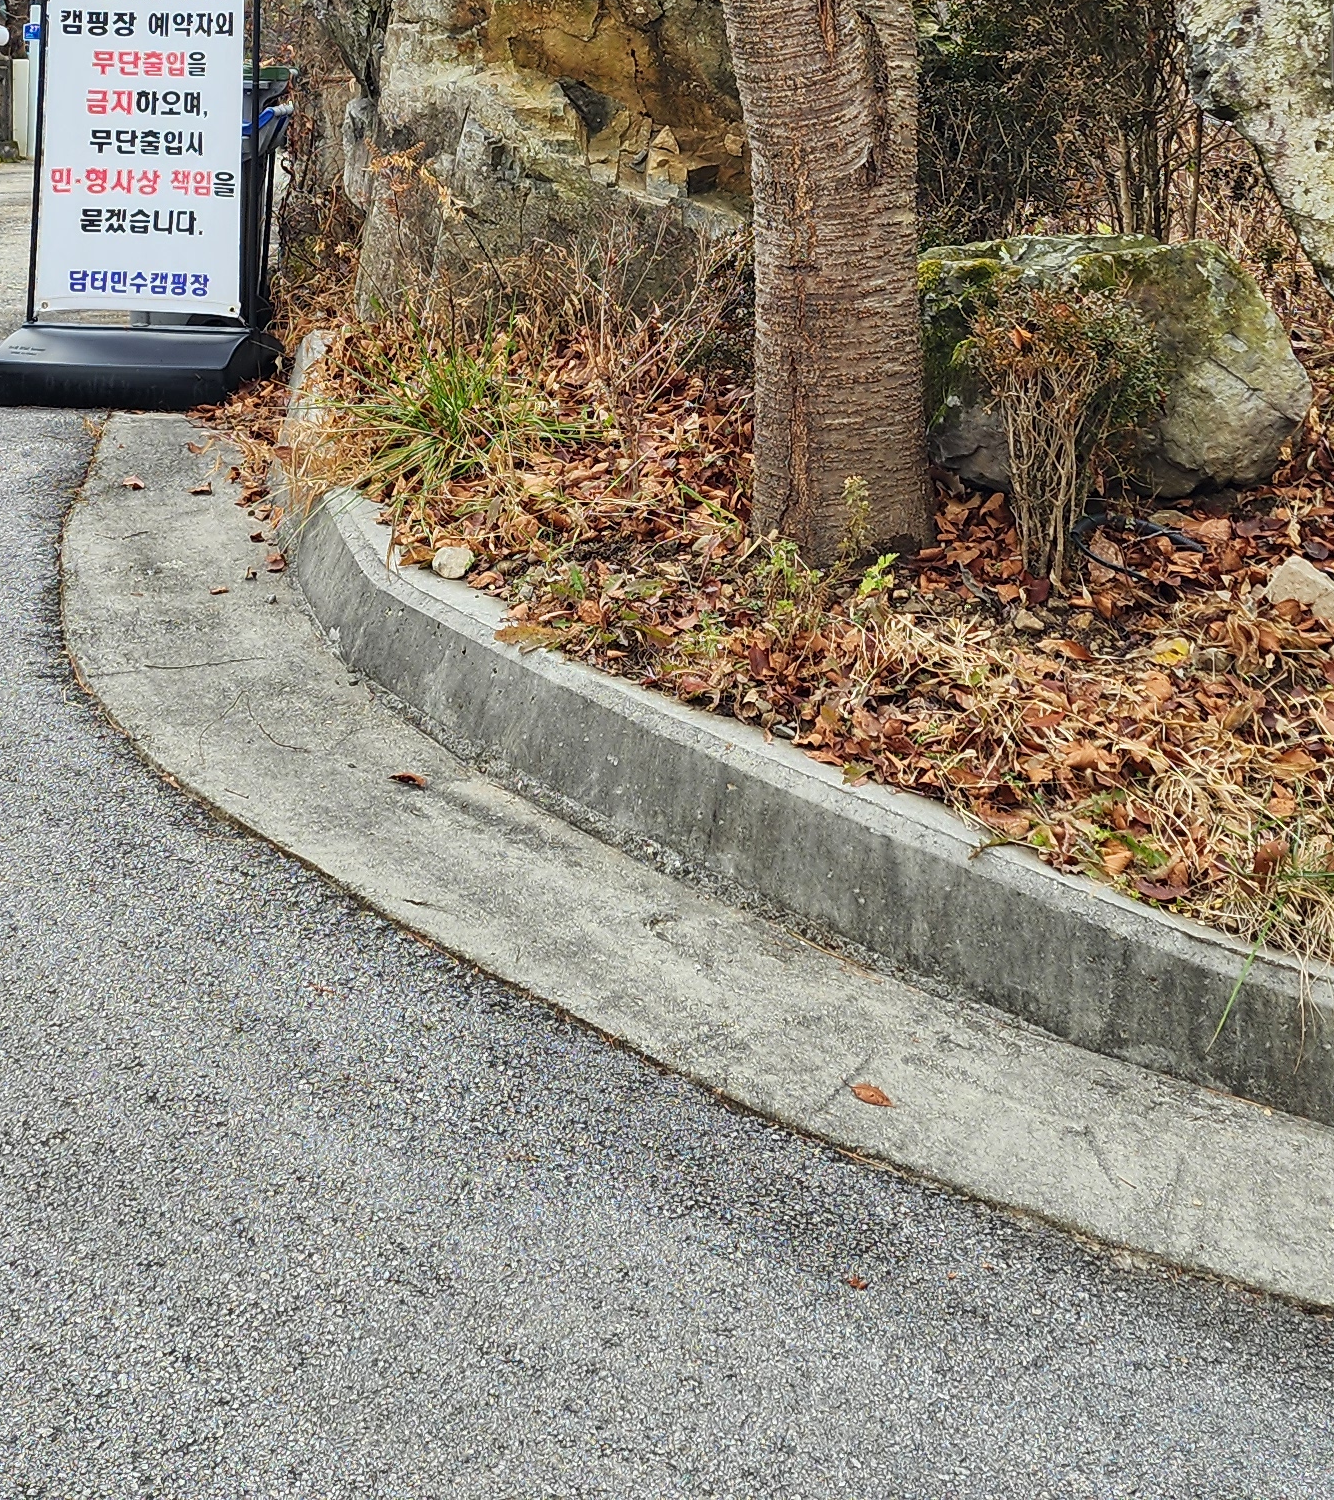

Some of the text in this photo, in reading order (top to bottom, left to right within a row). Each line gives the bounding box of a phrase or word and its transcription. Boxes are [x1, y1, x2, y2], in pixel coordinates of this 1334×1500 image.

[60, 9, 234, 38] 캠핑장 예약자외
[92, 50, 207, 77] 무단출입을
[86, 89, 208, 118] 금지하오며,
[89, 129, 204, 157] 무단출입시
[170, 168, 236, 198] 책임을
[80, 208, 204, 236] 묻겠습니다.
[69, 269, 210, 297] 담터민수캠핑장
